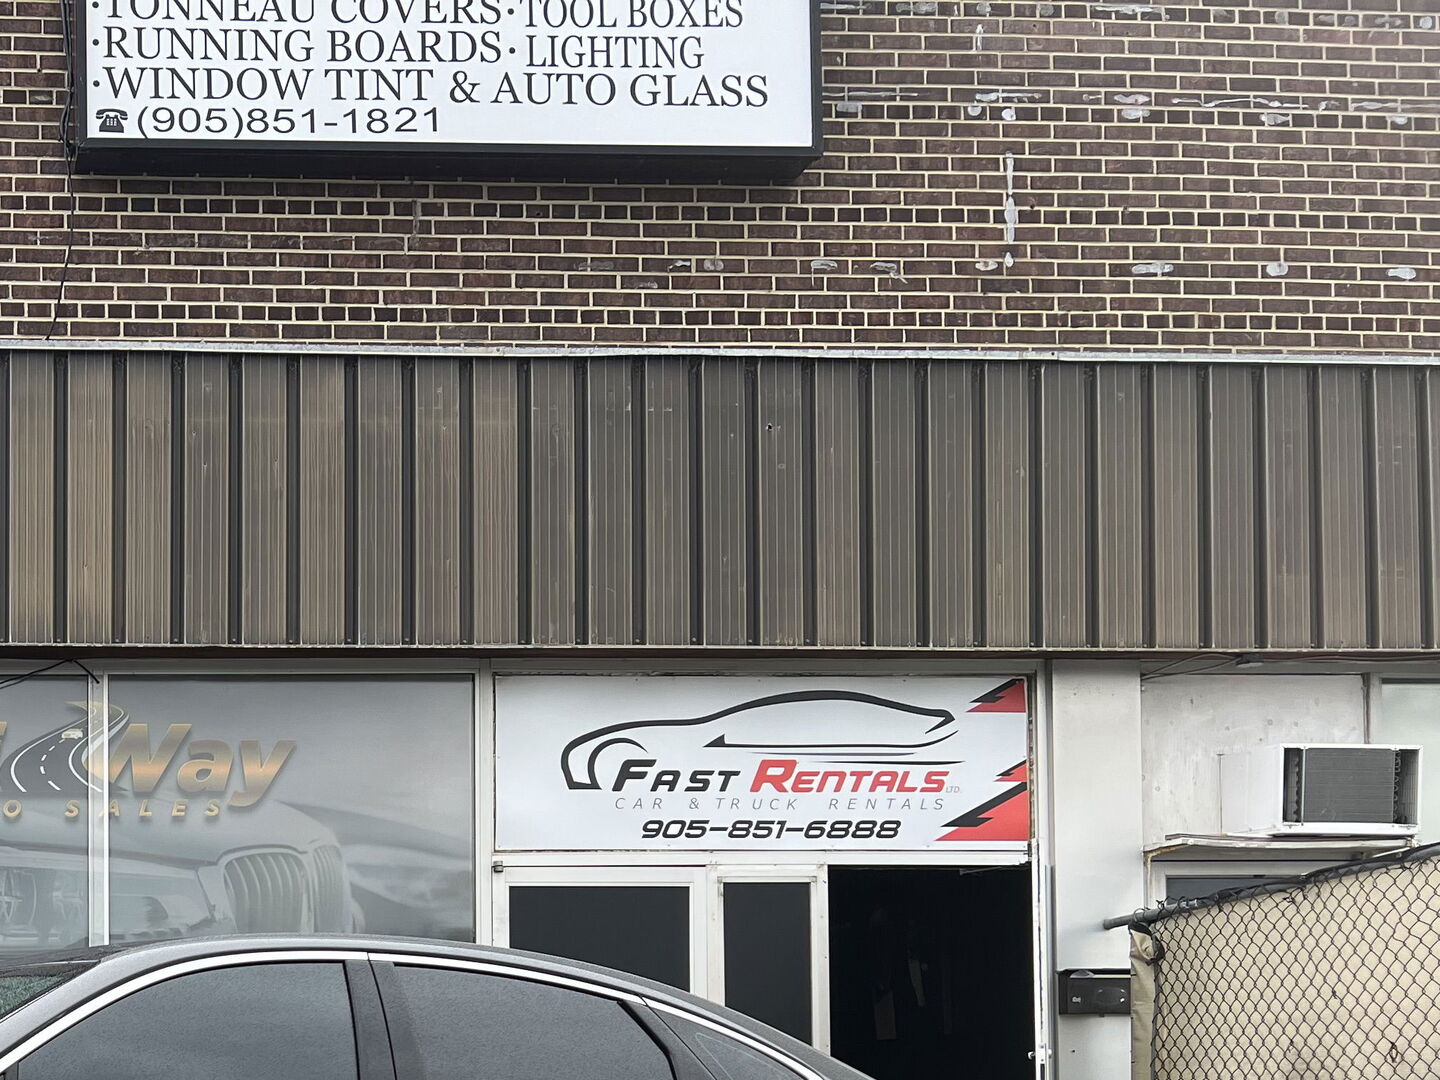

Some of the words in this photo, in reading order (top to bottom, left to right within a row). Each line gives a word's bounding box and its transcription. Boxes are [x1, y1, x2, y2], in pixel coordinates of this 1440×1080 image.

[331, 0, 502, 25] COVERS
[520, 0, 617, 28] TOOL
[627, 0, 744, 28] BOXES
[103, 26, 315, 62] RUNNING
[327, 29, 502, 64] BOARDS
[526, 35, 705, 69] LIGHTING
[102, 67, 315, 100] WINDOW
[324, 69, 434, 101] TINT
[449, 71, 481, 104] &
[490, 72, 617, 105] AUTO
[630, 75, 768, 107] GLASS
[137, 106, 440, 139] (905)851-1821
[612, 759, 742, 792] FAST
[750, 759, 950, 793] RENTALS
[64, 800, 221, 817] SALES
[615, 797, 664, 810] CAR
[689, 797, 700, 810] &
[716, 798, 797, 810] TRUCK
[829, 798, 944, 810] RENTALS
[642, 819, 902, 839] 905-851-6888
